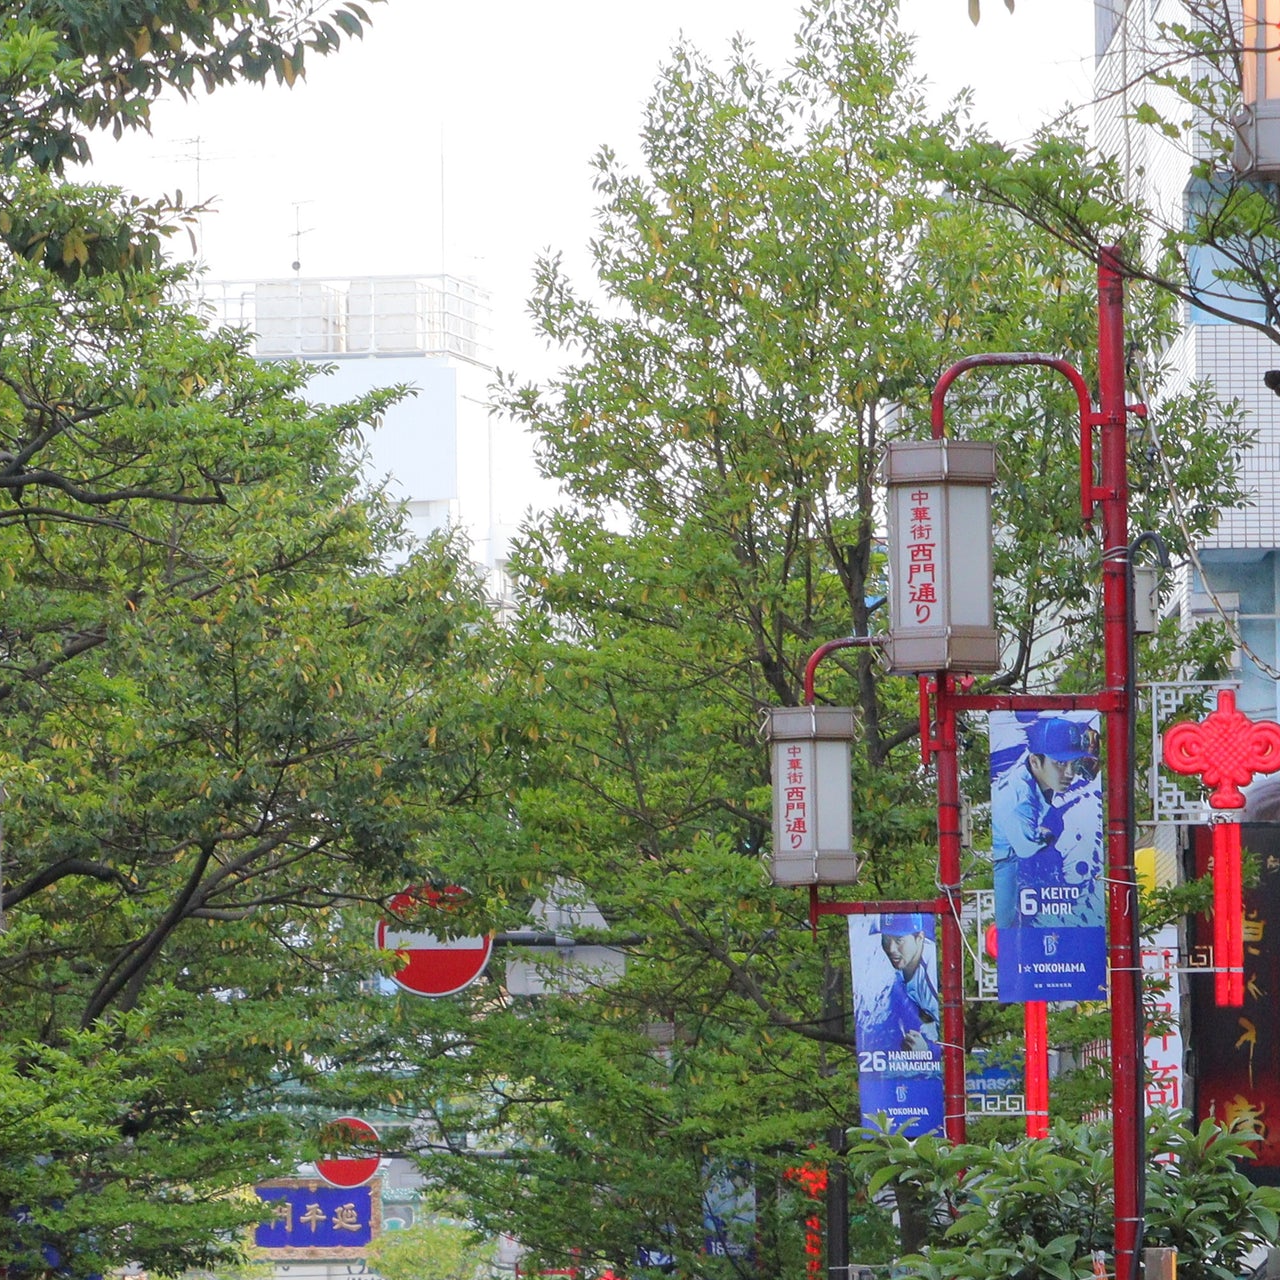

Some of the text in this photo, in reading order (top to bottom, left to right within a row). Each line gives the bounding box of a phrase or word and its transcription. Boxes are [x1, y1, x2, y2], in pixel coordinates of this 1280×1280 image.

[906, 489, 938, 624] 中華街西門通り
[784, 744, 808, 849] 中華街西門通り
[1020, 886, 1080, 916] 6 KEITO
[1041, 902, 1072, 915] MORI
[1032, 962, 1086, 973] YOKOHAMA
[858, 1050, 933, 1073] 26 HARUHIRO
[888, 1060, 941, 1072] HAMAGUCHI
[887, 1107, 929, 1117] YOKOHAMA
